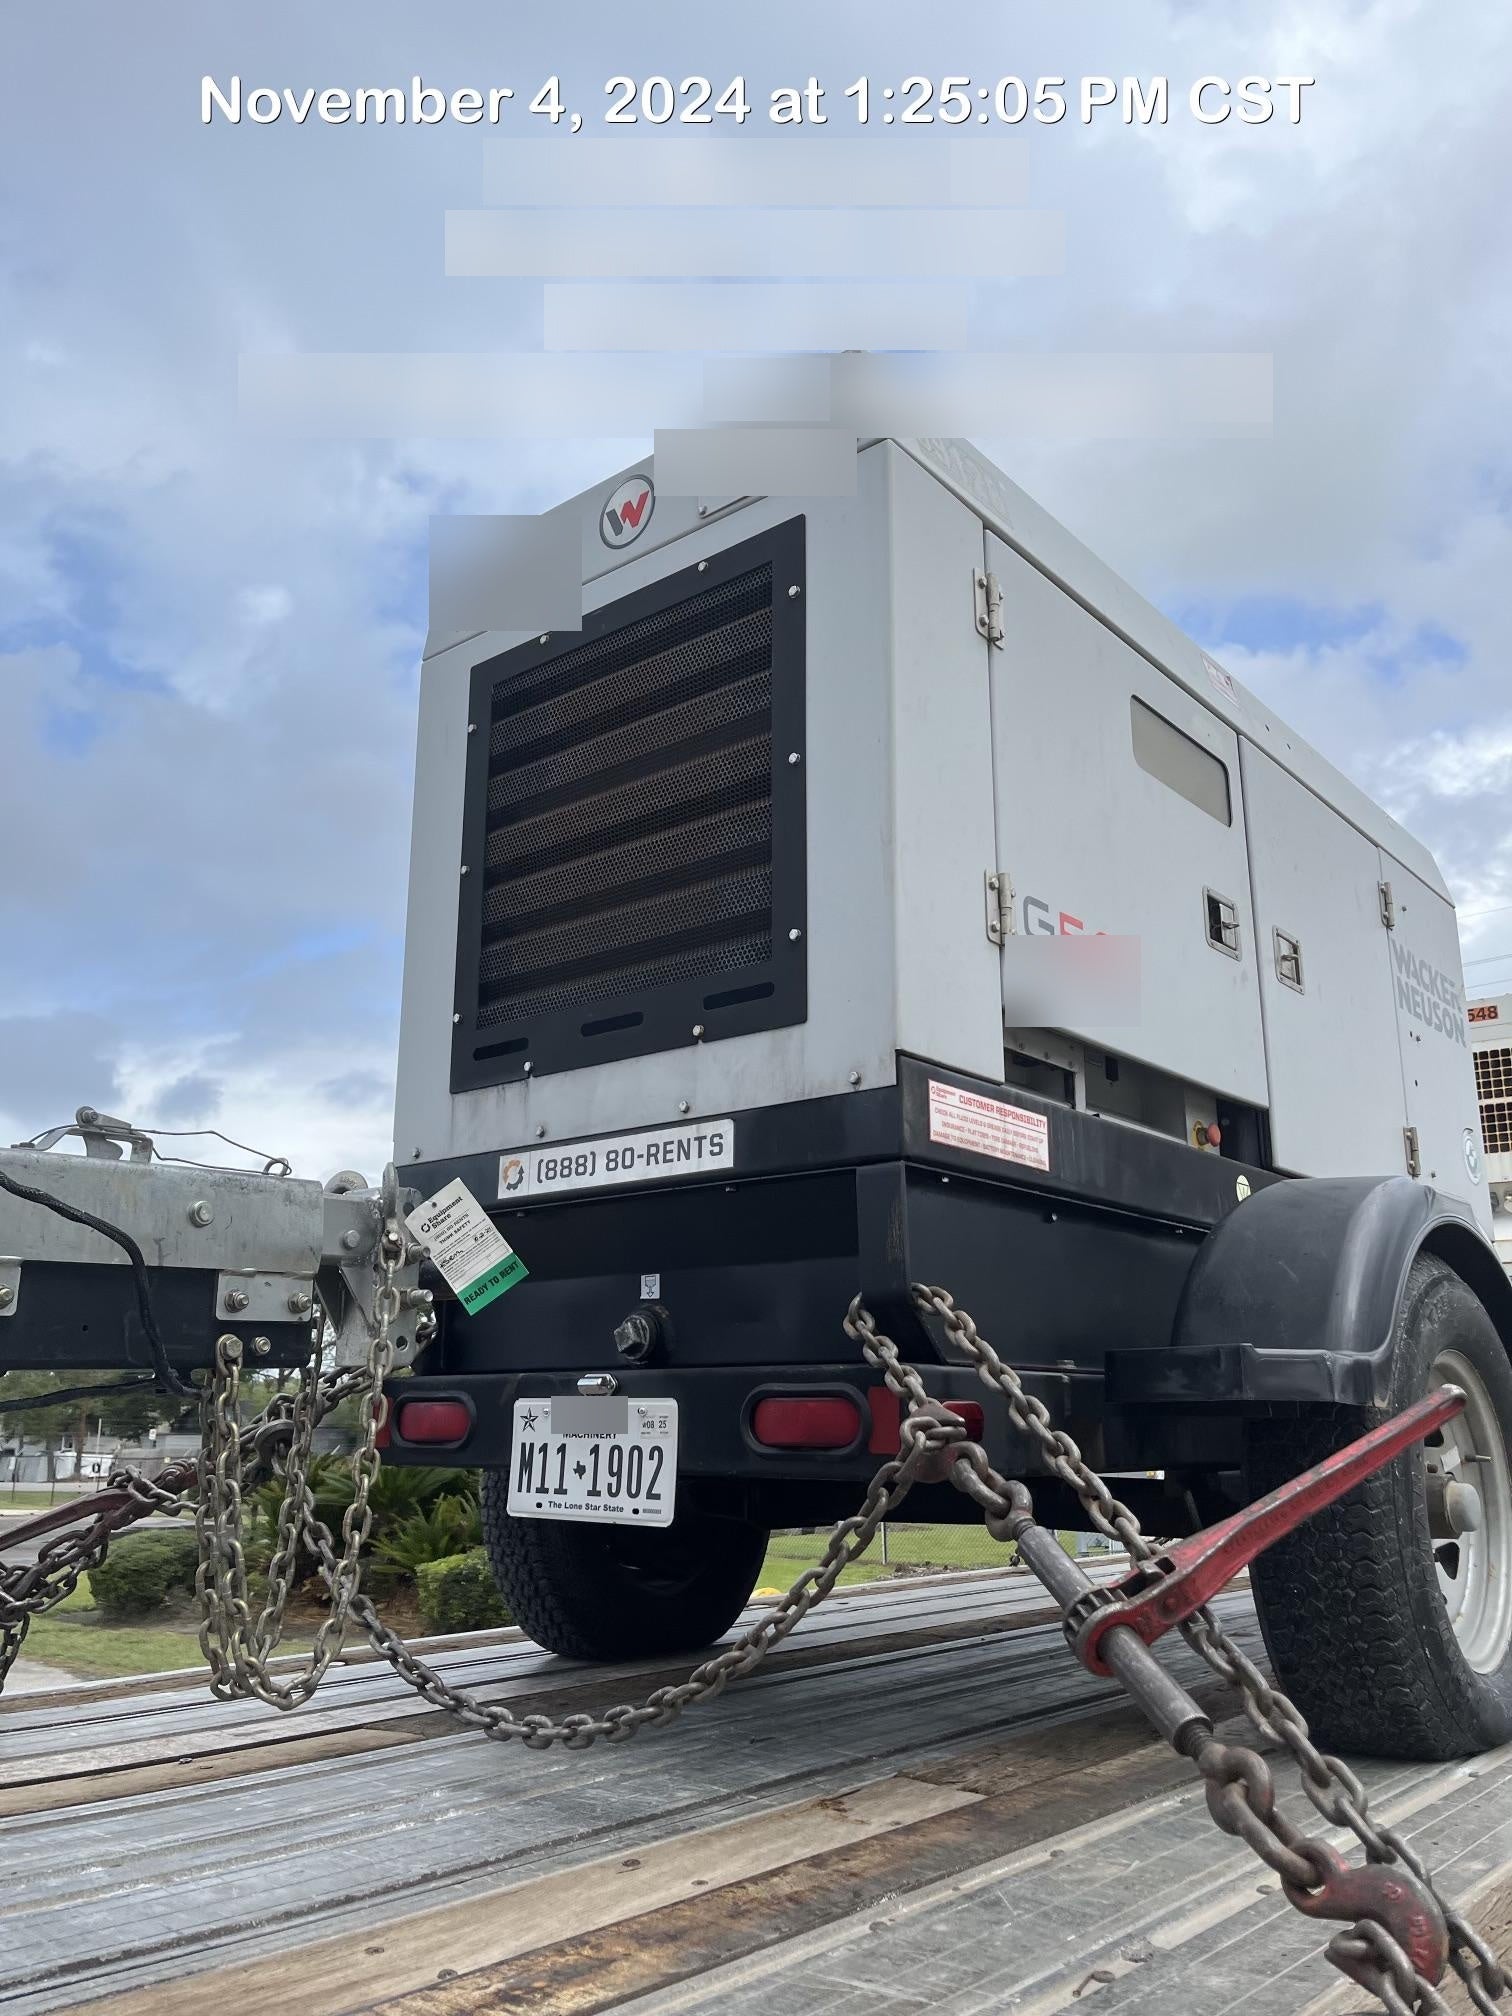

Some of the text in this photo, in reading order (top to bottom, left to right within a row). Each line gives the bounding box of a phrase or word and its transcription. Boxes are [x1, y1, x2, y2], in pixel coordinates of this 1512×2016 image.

[1390, 938, 1463, 1015] WACKER
[1397, 976, 1467, 1048] NEUSON
[959, 1094, 995, 1113] CUSTOMER
[995, 1105, 1046, 1128] RESPONSIBILITY
[537, 1132, 724, 1183] (888) 80-RENTS
[428, 1196, 463, 1224] Equipment
[431, 1213, 451, 1229] Share
[453, 1220, 471, 1234] SAFETY
[463, 1261, 520, 1305] READY TO RENT
[517, 1442, 664, 1501] M11 1902
[548, 1500, 624, 1513] The Lone Star State
